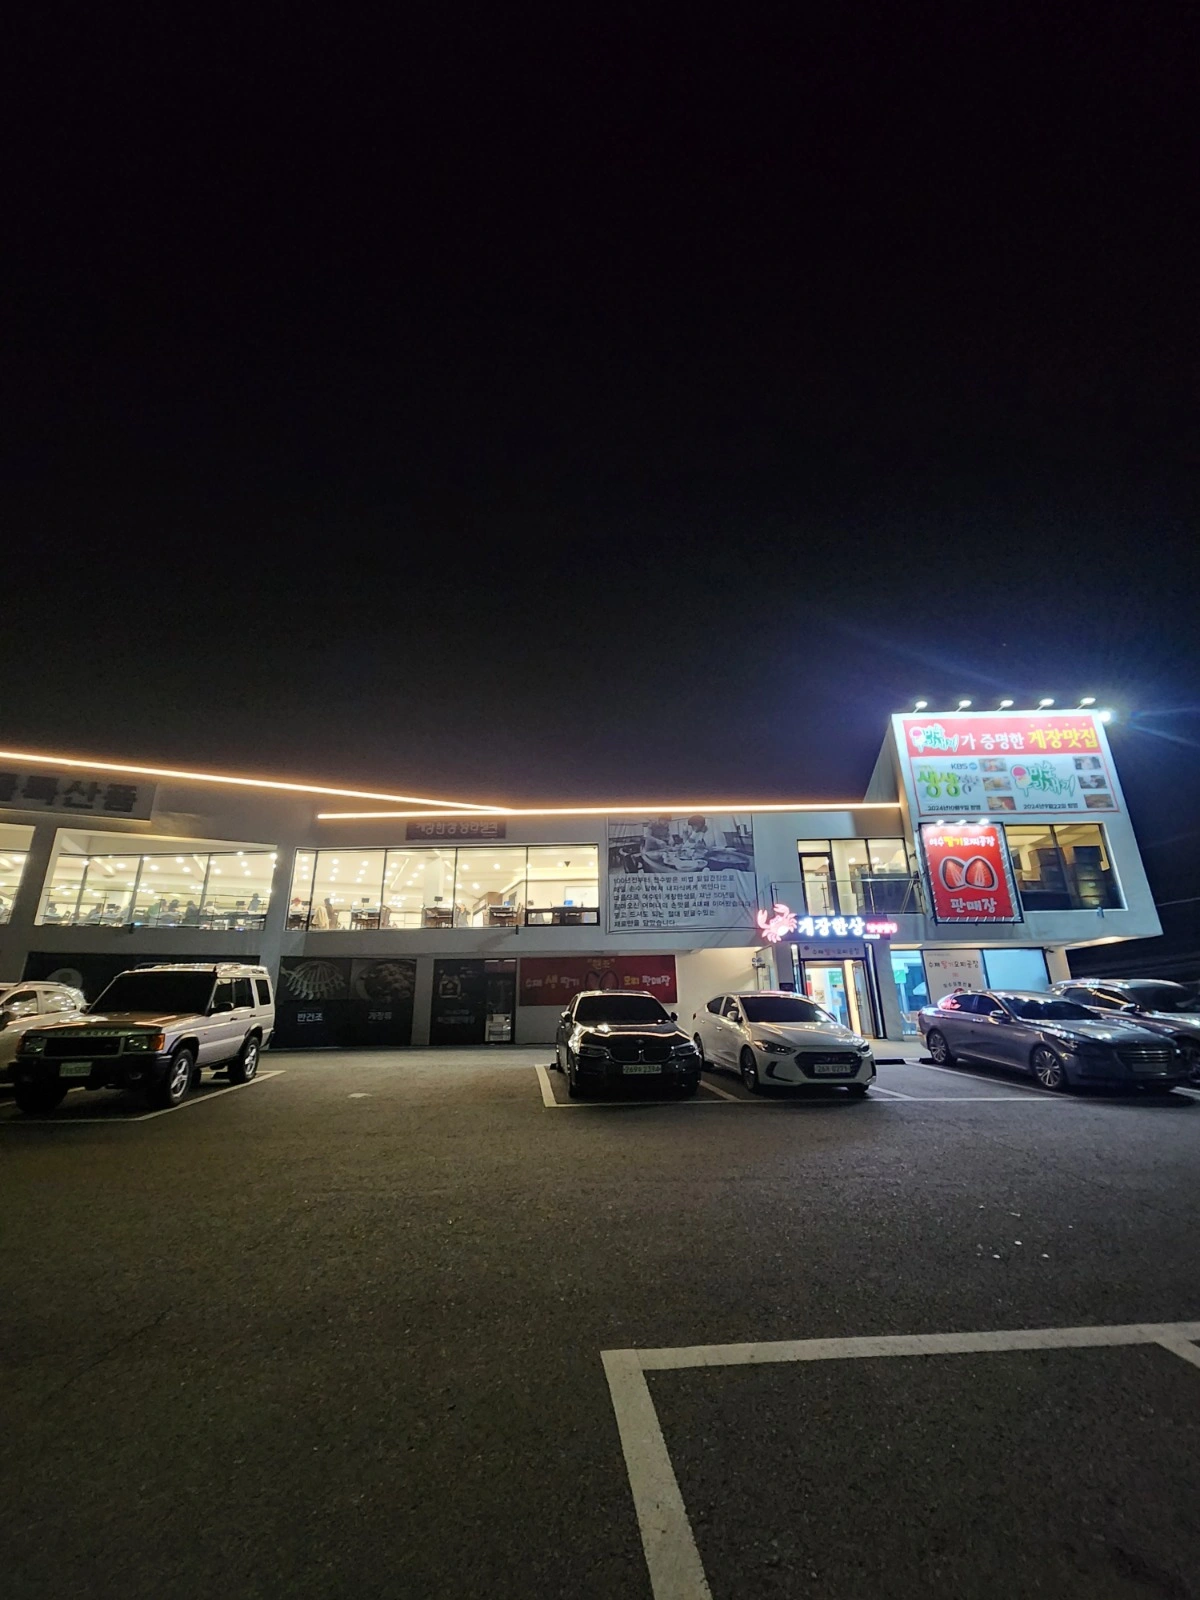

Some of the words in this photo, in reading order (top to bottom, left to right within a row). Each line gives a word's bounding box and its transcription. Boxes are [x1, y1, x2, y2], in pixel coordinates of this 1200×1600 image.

[961, 733, 977, 750] 가
[980, 733, 1025, 751] 증명한
[1027, 727, 1099, 750] 게장맛집
[950, 897, 998, 913] 판매장
[798, 917, 866, 937] 게장한상
